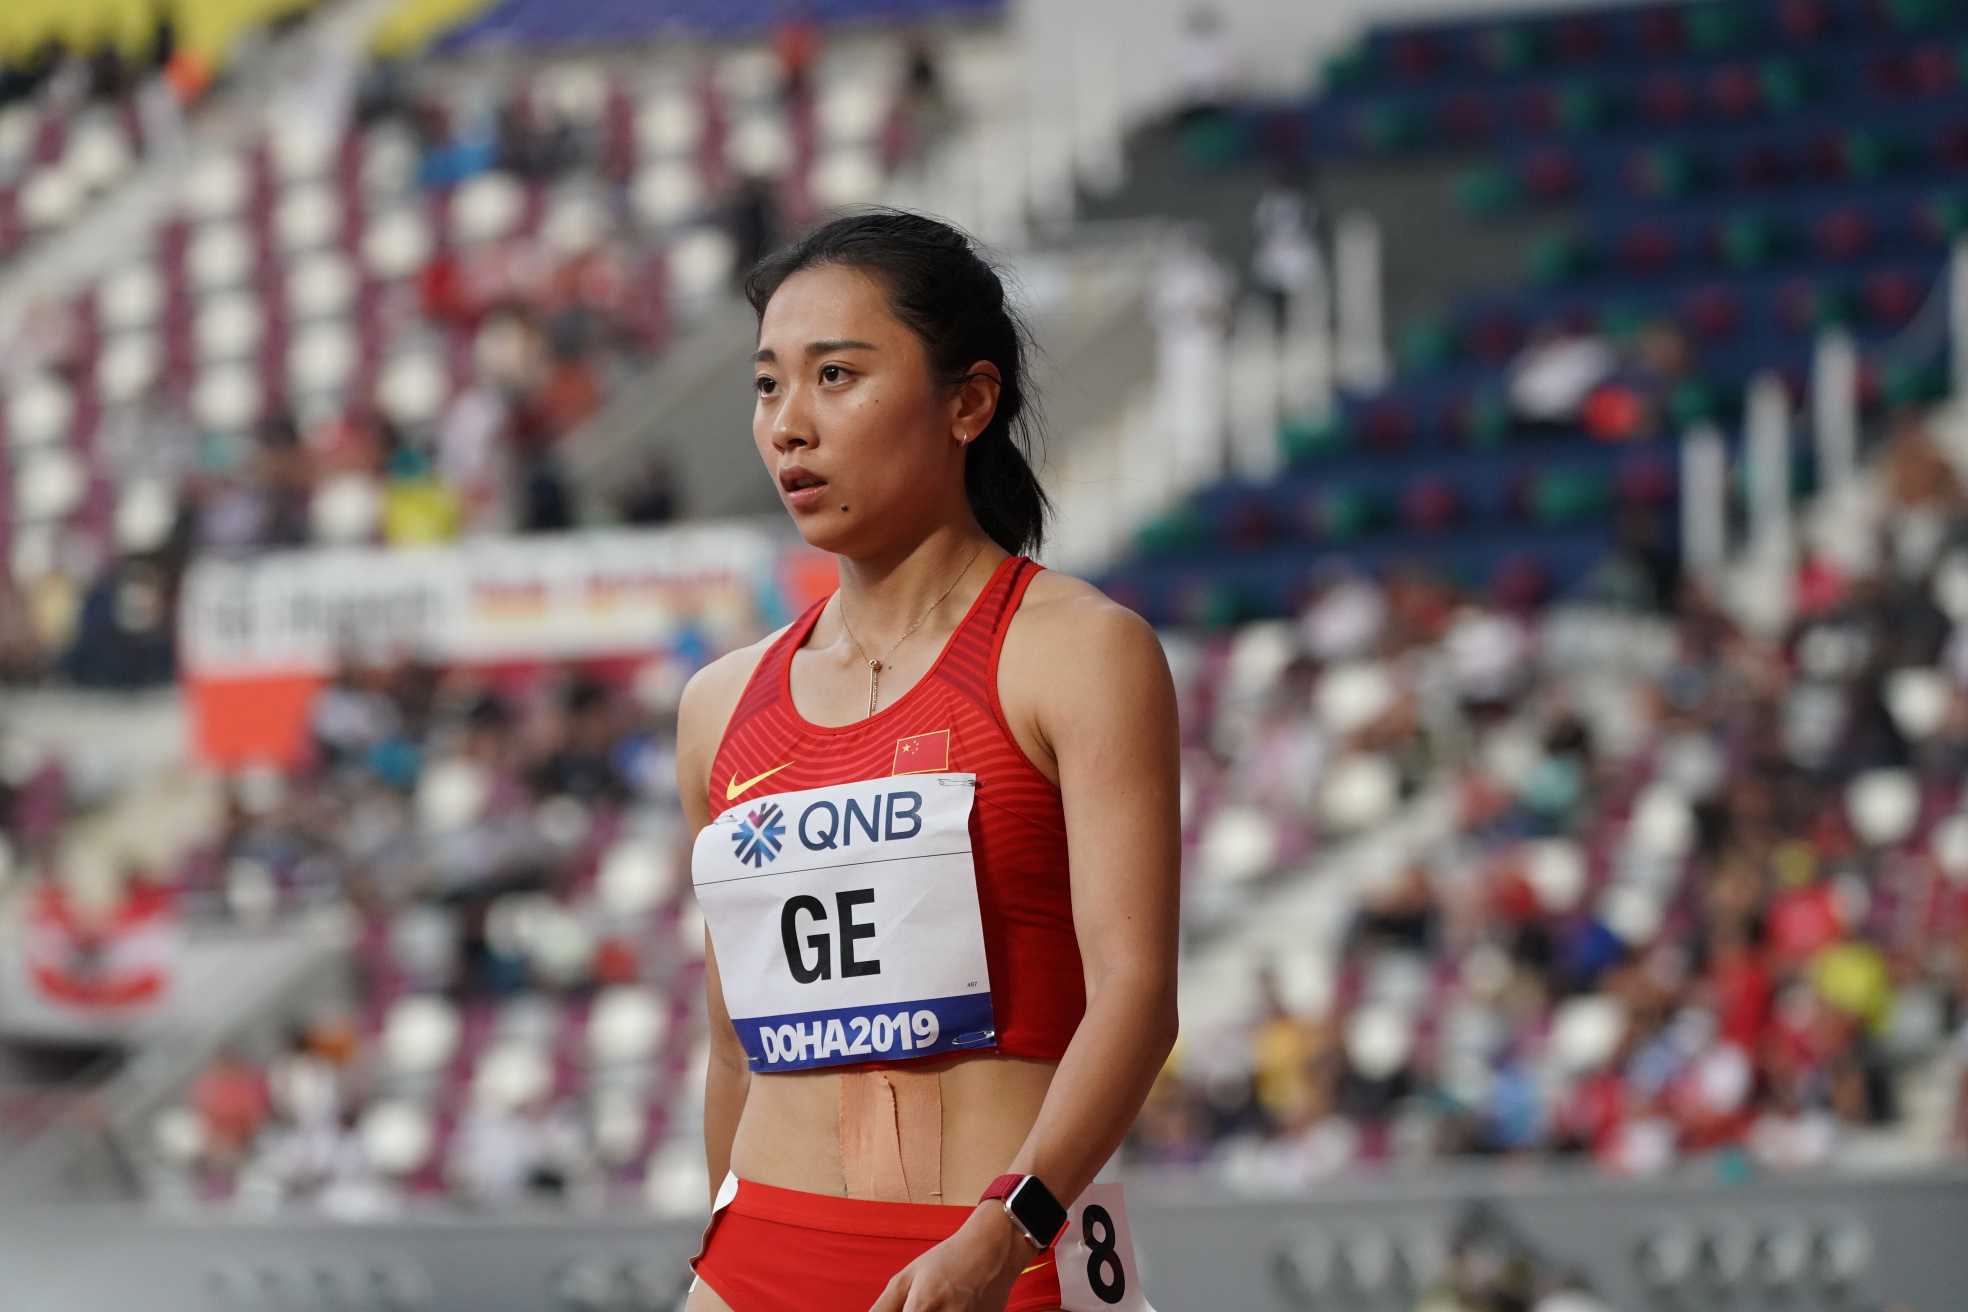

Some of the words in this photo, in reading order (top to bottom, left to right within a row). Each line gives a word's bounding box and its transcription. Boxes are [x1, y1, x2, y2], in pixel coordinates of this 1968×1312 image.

[798, 790, 923, 851] QNB
[780, 888, 881, 984] GE
[1082, 1204, 1126, 1304] 8
